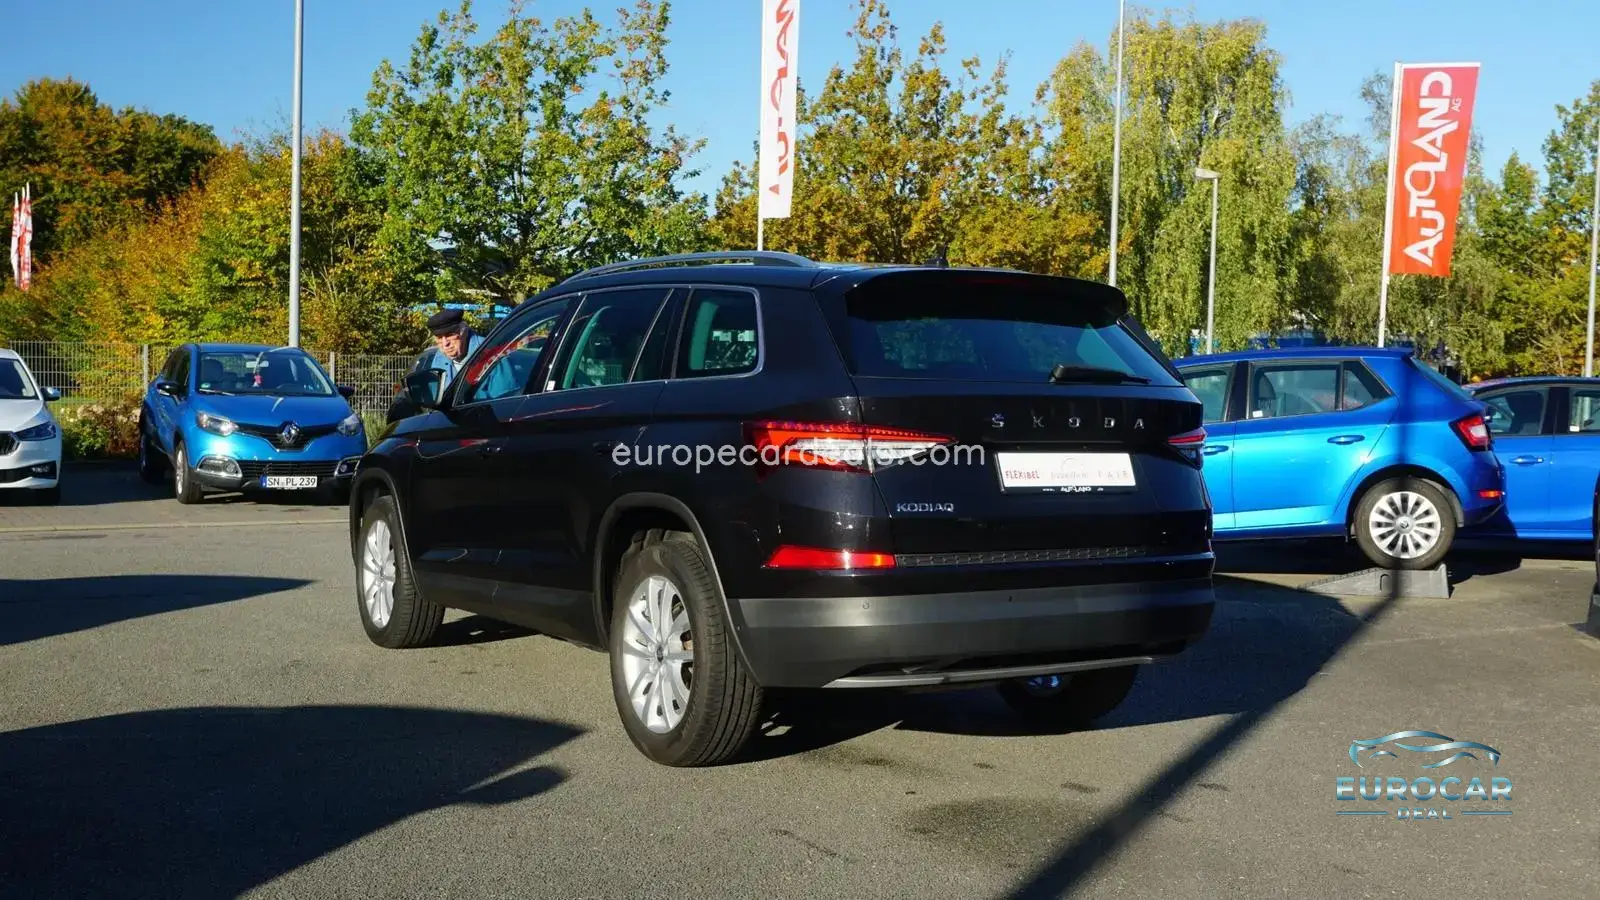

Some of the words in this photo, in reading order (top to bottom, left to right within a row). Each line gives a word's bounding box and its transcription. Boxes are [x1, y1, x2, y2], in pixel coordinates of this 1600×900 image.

[1452, 97, 1462, 112] AG
[1403, 71, 1459, 267] AUTOLAND
[1004, 469, 1041, 480] FLEXIBEL
[267, 477, 280, 487] SN
[285, 477, 298, 487] PL
[299, 477, 316, 487] 239
[896, 502, 955, 512] KODIAQ
